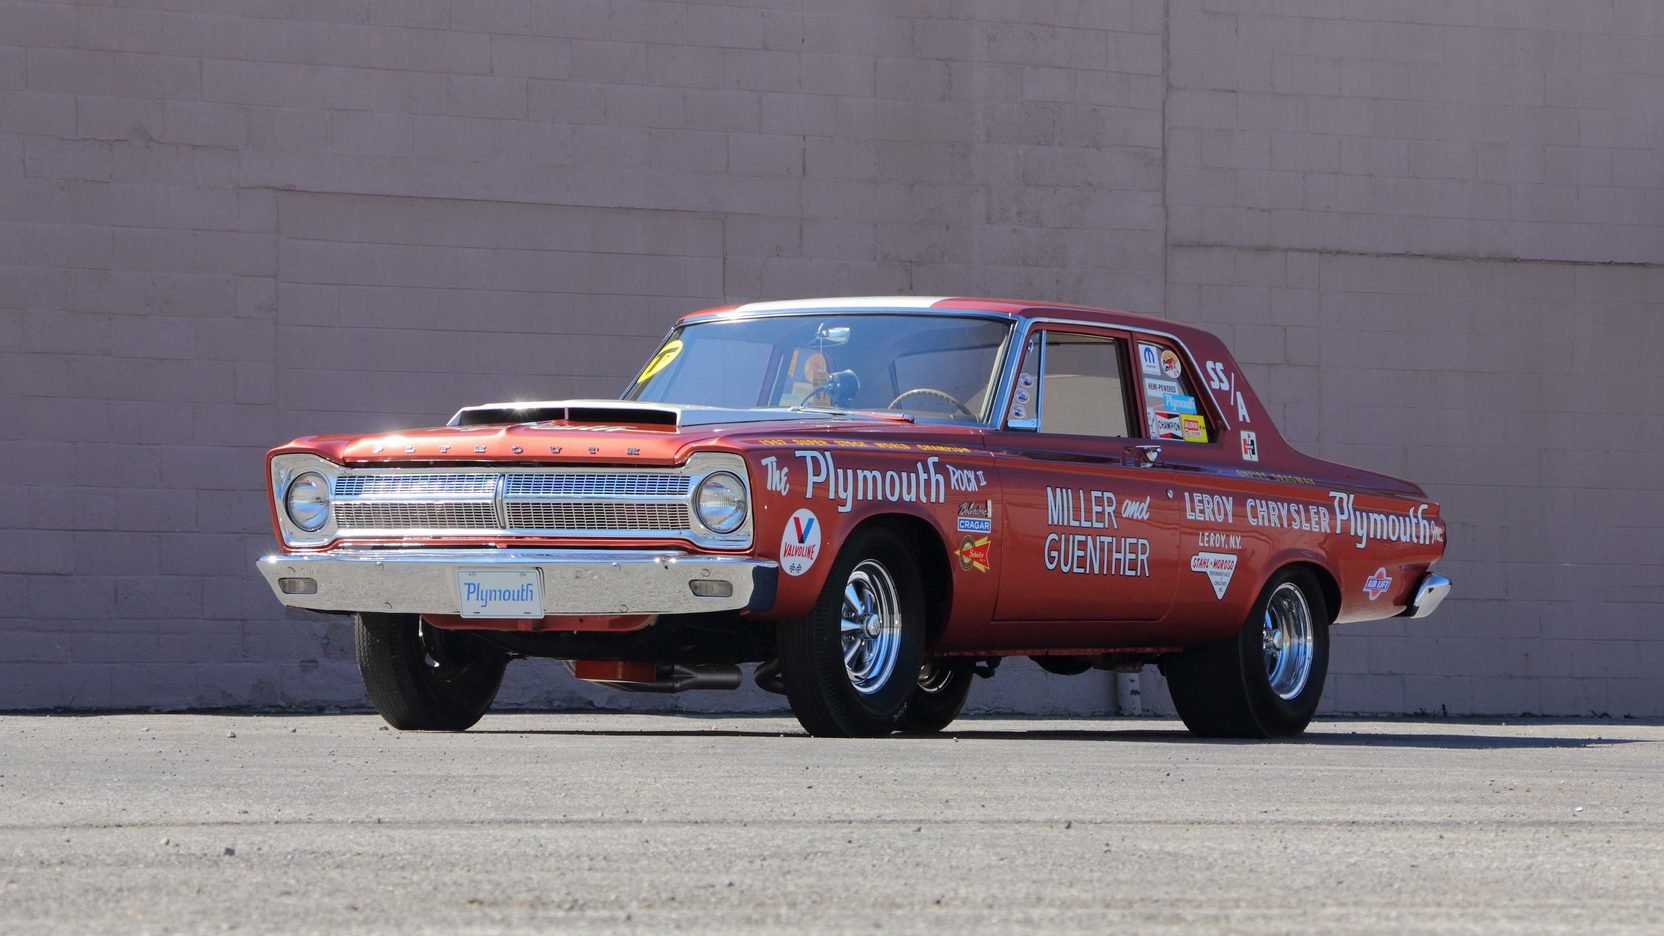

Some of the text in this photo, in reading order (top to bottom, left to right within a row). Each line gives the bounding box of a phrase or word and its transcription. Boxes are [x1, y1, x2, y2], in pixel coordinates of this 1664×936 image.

[795, 450, 945, 513] Plymouth
[946, 463, 978, 492] ROCK
[1046, 487, 1150, 529] MILLER and
[1185, 492, 1233, 523] LEROY
[1246, 499, 1330, 534] CHRYSLER
[1329, 491, 1430, 548] Plymouth
[959, 521, 990, 530] CRAGAR
[783, 543, 816, 560] VALVOLINE
[1199, 532, 1228, 549] LEROY,
[1044, 533, 1149, 577] GUENTHER
[1193, 557, 1209, 569] STAHL
[464, 582, 533, 608] Plymouth
